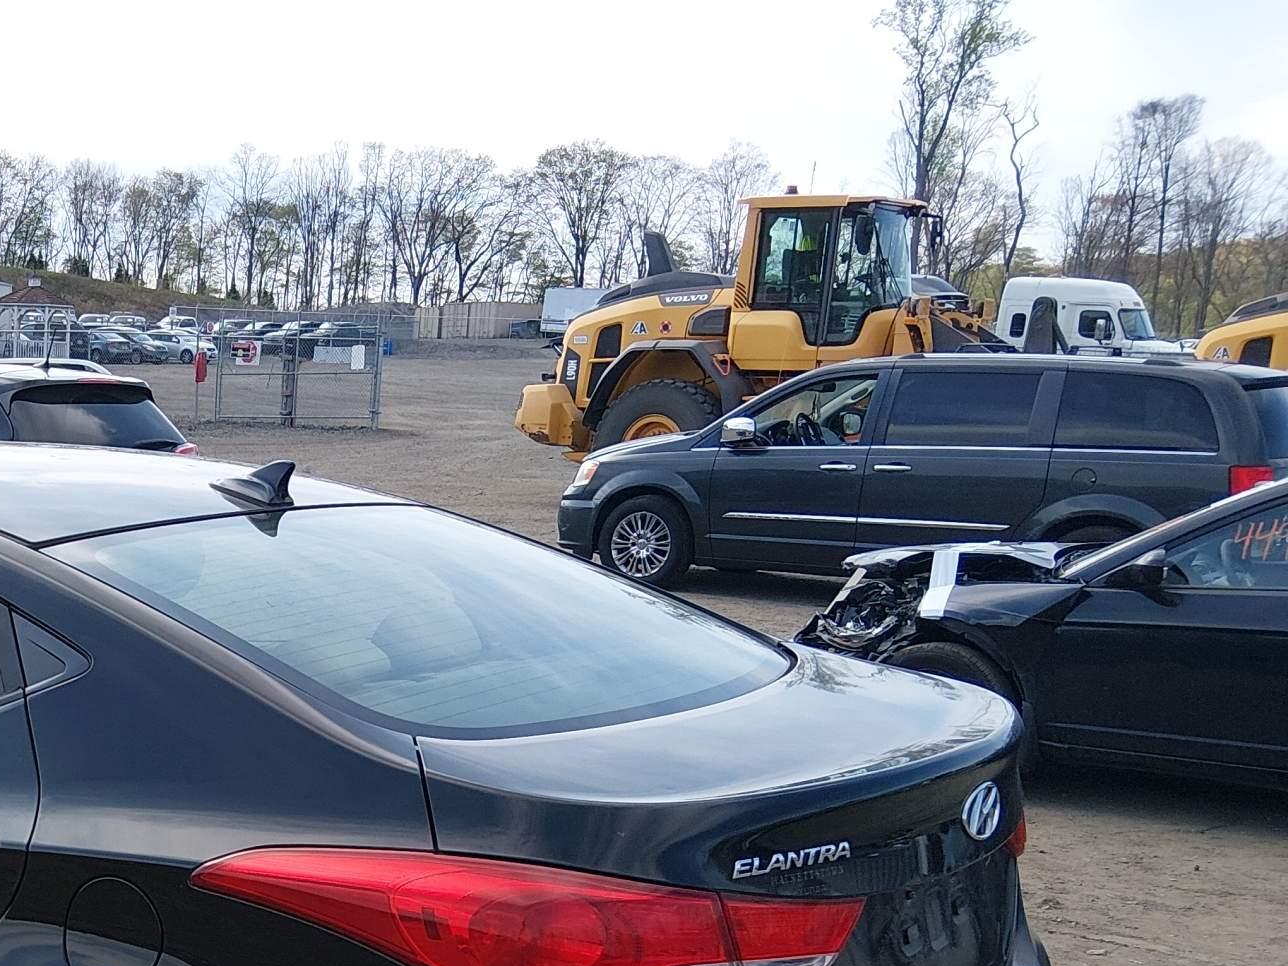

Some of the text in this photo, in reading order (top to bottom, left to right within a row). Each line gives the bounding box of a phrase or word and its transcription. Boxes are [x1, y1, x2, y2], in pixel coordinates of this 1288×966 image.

[664, 294, 708, 303] VOLVO
[567, 360, 577, 380] L90H
[733, 842, 851, 879] ELANTRA
